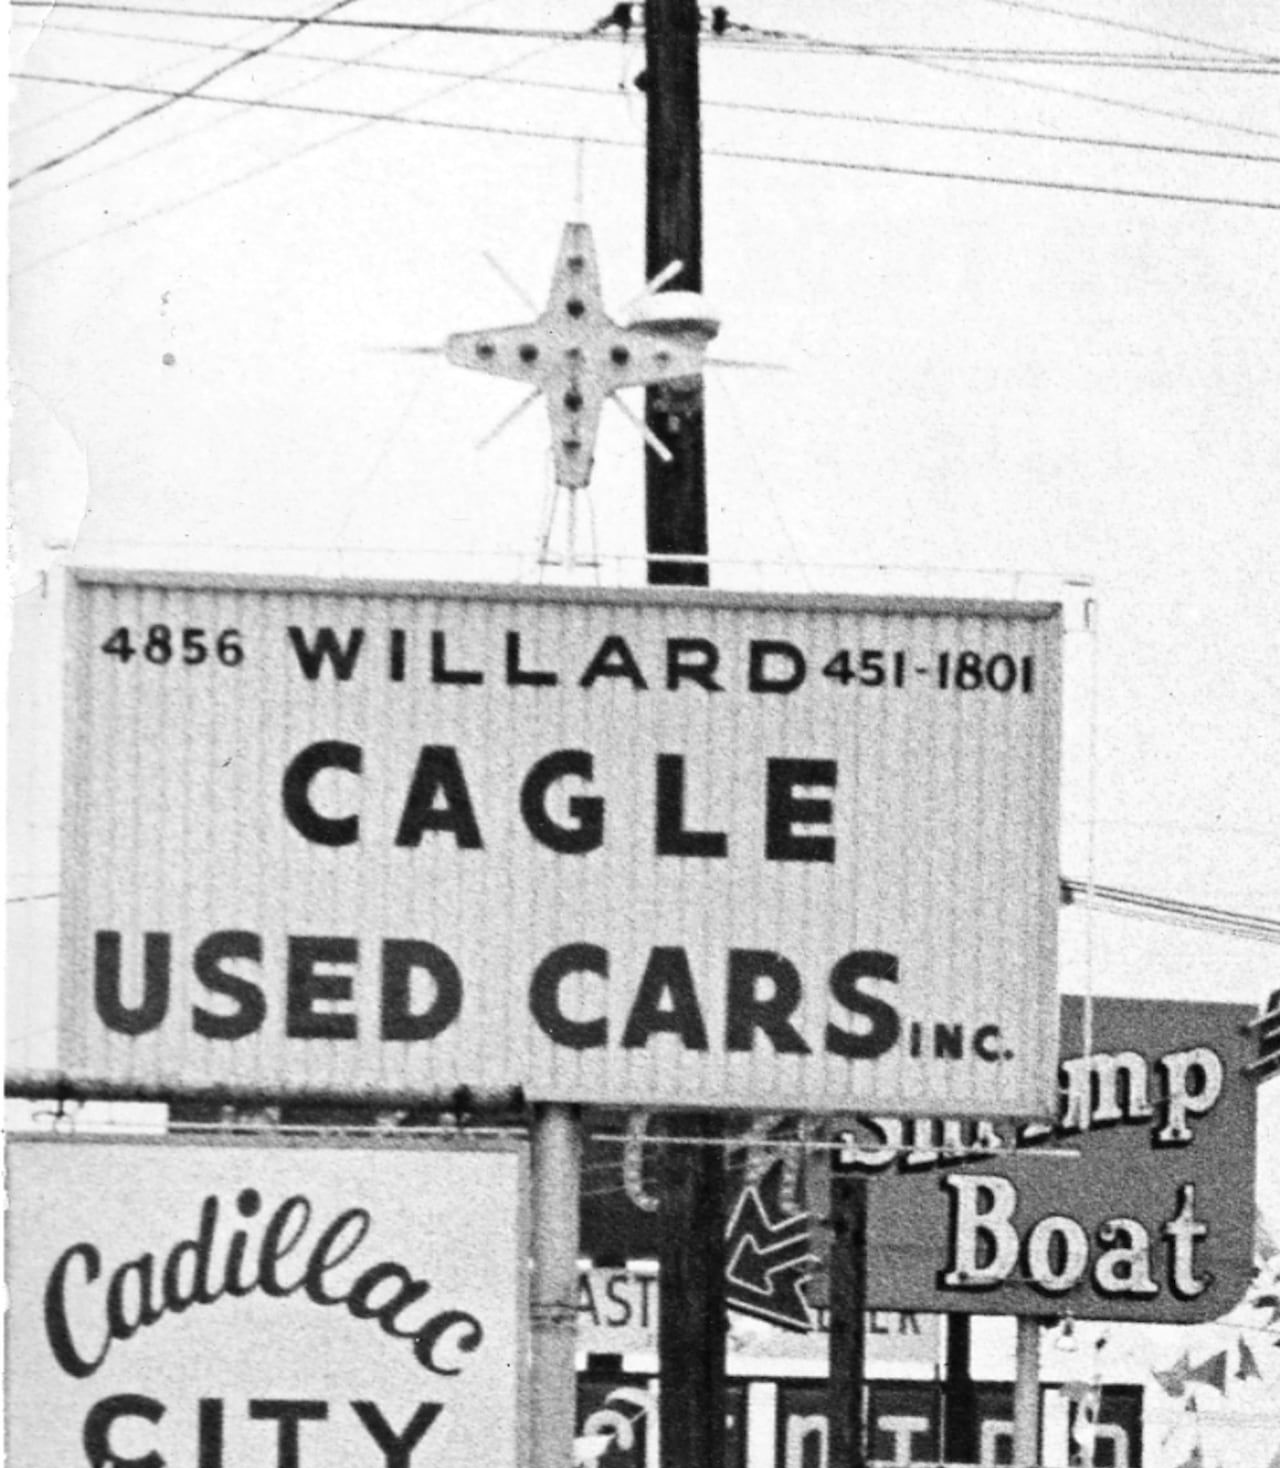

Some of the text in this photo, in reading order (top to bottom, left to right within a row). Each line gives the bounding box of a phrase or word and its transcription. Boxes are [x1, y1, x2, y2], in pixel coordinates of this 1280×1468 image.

[101, 623, 1035, 694] 4856 WILLARD 451-1801
[281, 740, 838, 863] CAGLE
[92, 930, 1015, 1062] USED CARS INC.
[44, 1187, 484, 1378] Cadillac
[944, 1173, 1213, 1297] Boat
[577, 1272, 659, 1328] AST
